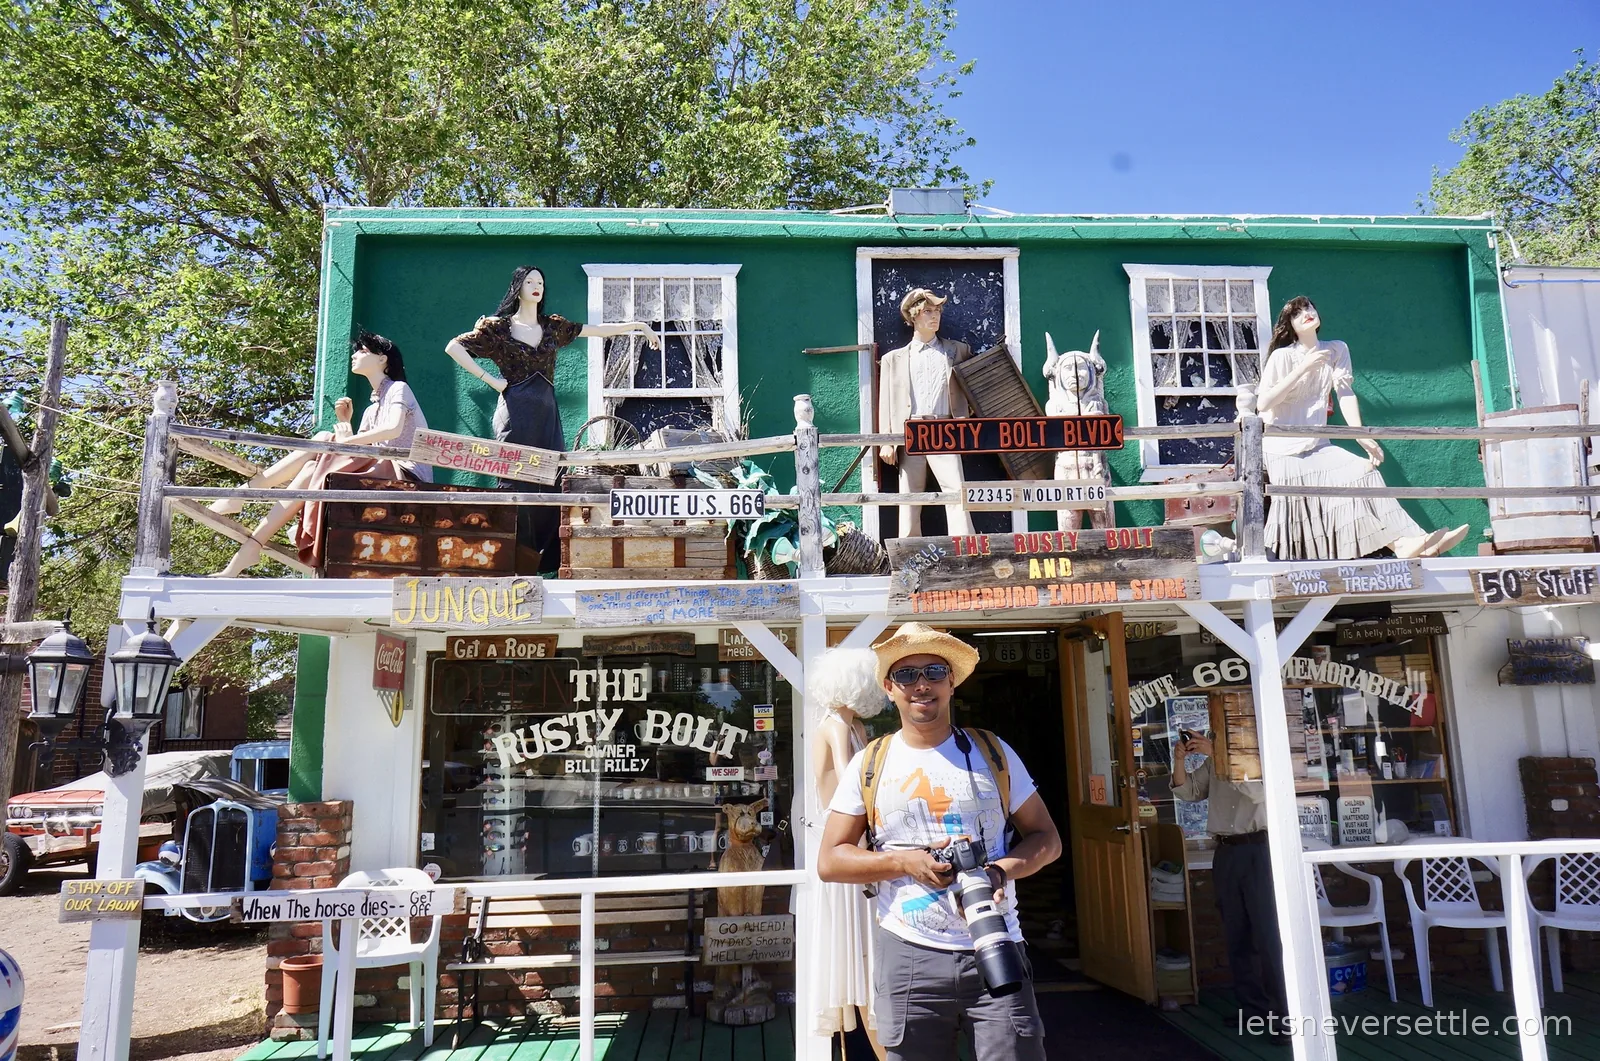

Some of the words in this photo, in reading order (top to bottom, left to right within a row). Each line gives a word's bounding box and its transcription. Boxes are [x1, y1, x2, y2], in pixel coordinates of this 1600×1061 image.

[917, 423, 982, 450] RUSTY
[1000, 421, 1047, 448] BOLT
[1063, 419, 1112, 446] BLVD
[425, 435, 464, 450] Where
[471, 442, 490, 456] The
[498, 446, 522, 460] hell
[968, 488, 1013, 503] 22345
[1087, 486, 1104, 500] 66
[622, 494, 680, 516] ROUTE
[687, 494, 722, 516] U.S.
[730, 494, 753, 516] 66
[951, 535, 991, 557] THE
[1014, 531, 1078, 555] RUSTY
[1105, 528, 1153, 550] BOLT
[1029, 557, 1073, 580] AND
[1338, 566, 1357, 577] MY
[1374, 561, 1411, 577] JUNK
[1292, 580, 1329, 596] YOUR
[1342, 572, 1413, 593] TREASURE
[626, 589, 670, 600] different
[909, 585, 1039, 614] THUNDERBIRD
[1047, 581, 1118, 606] INDIAN
[1130, 578, 1187, 601] STORE
[646, 609, 665, 622] and
[673, 607, 714, 620] MORE
[1356, 629, 1362, 638] A
[486, 644, 498, 657] A
[569, 668, 649, 702] THE
[1129, 674, 1180, 719] OUTE
[1192, 658, 1248, 688] 66
[492, 708, 624, 769] RUSTY
[643, 709, 749, 759] BOLT
[584, 745, 636, 758] OWNER
[565, 759, 598, 774] BILL
[604, 758, 650, 773] RILEY
[712, 769, 723, 777] WE
[723, 768, 740, 777] SHIP
[67, 881, 103, 895] STAY
[107, 881, 136, 895] OFF
[64, 898, 93, 911] OUR
[97, 899, 139, 912] LAWN
[287, 899, 310, 918] The
[314, 898, 355, 918] horse
[719, 923, 738, 934] GO
[744, 921, 786, 932] AHEAD!
[711, 951, 741, 962] HELL
